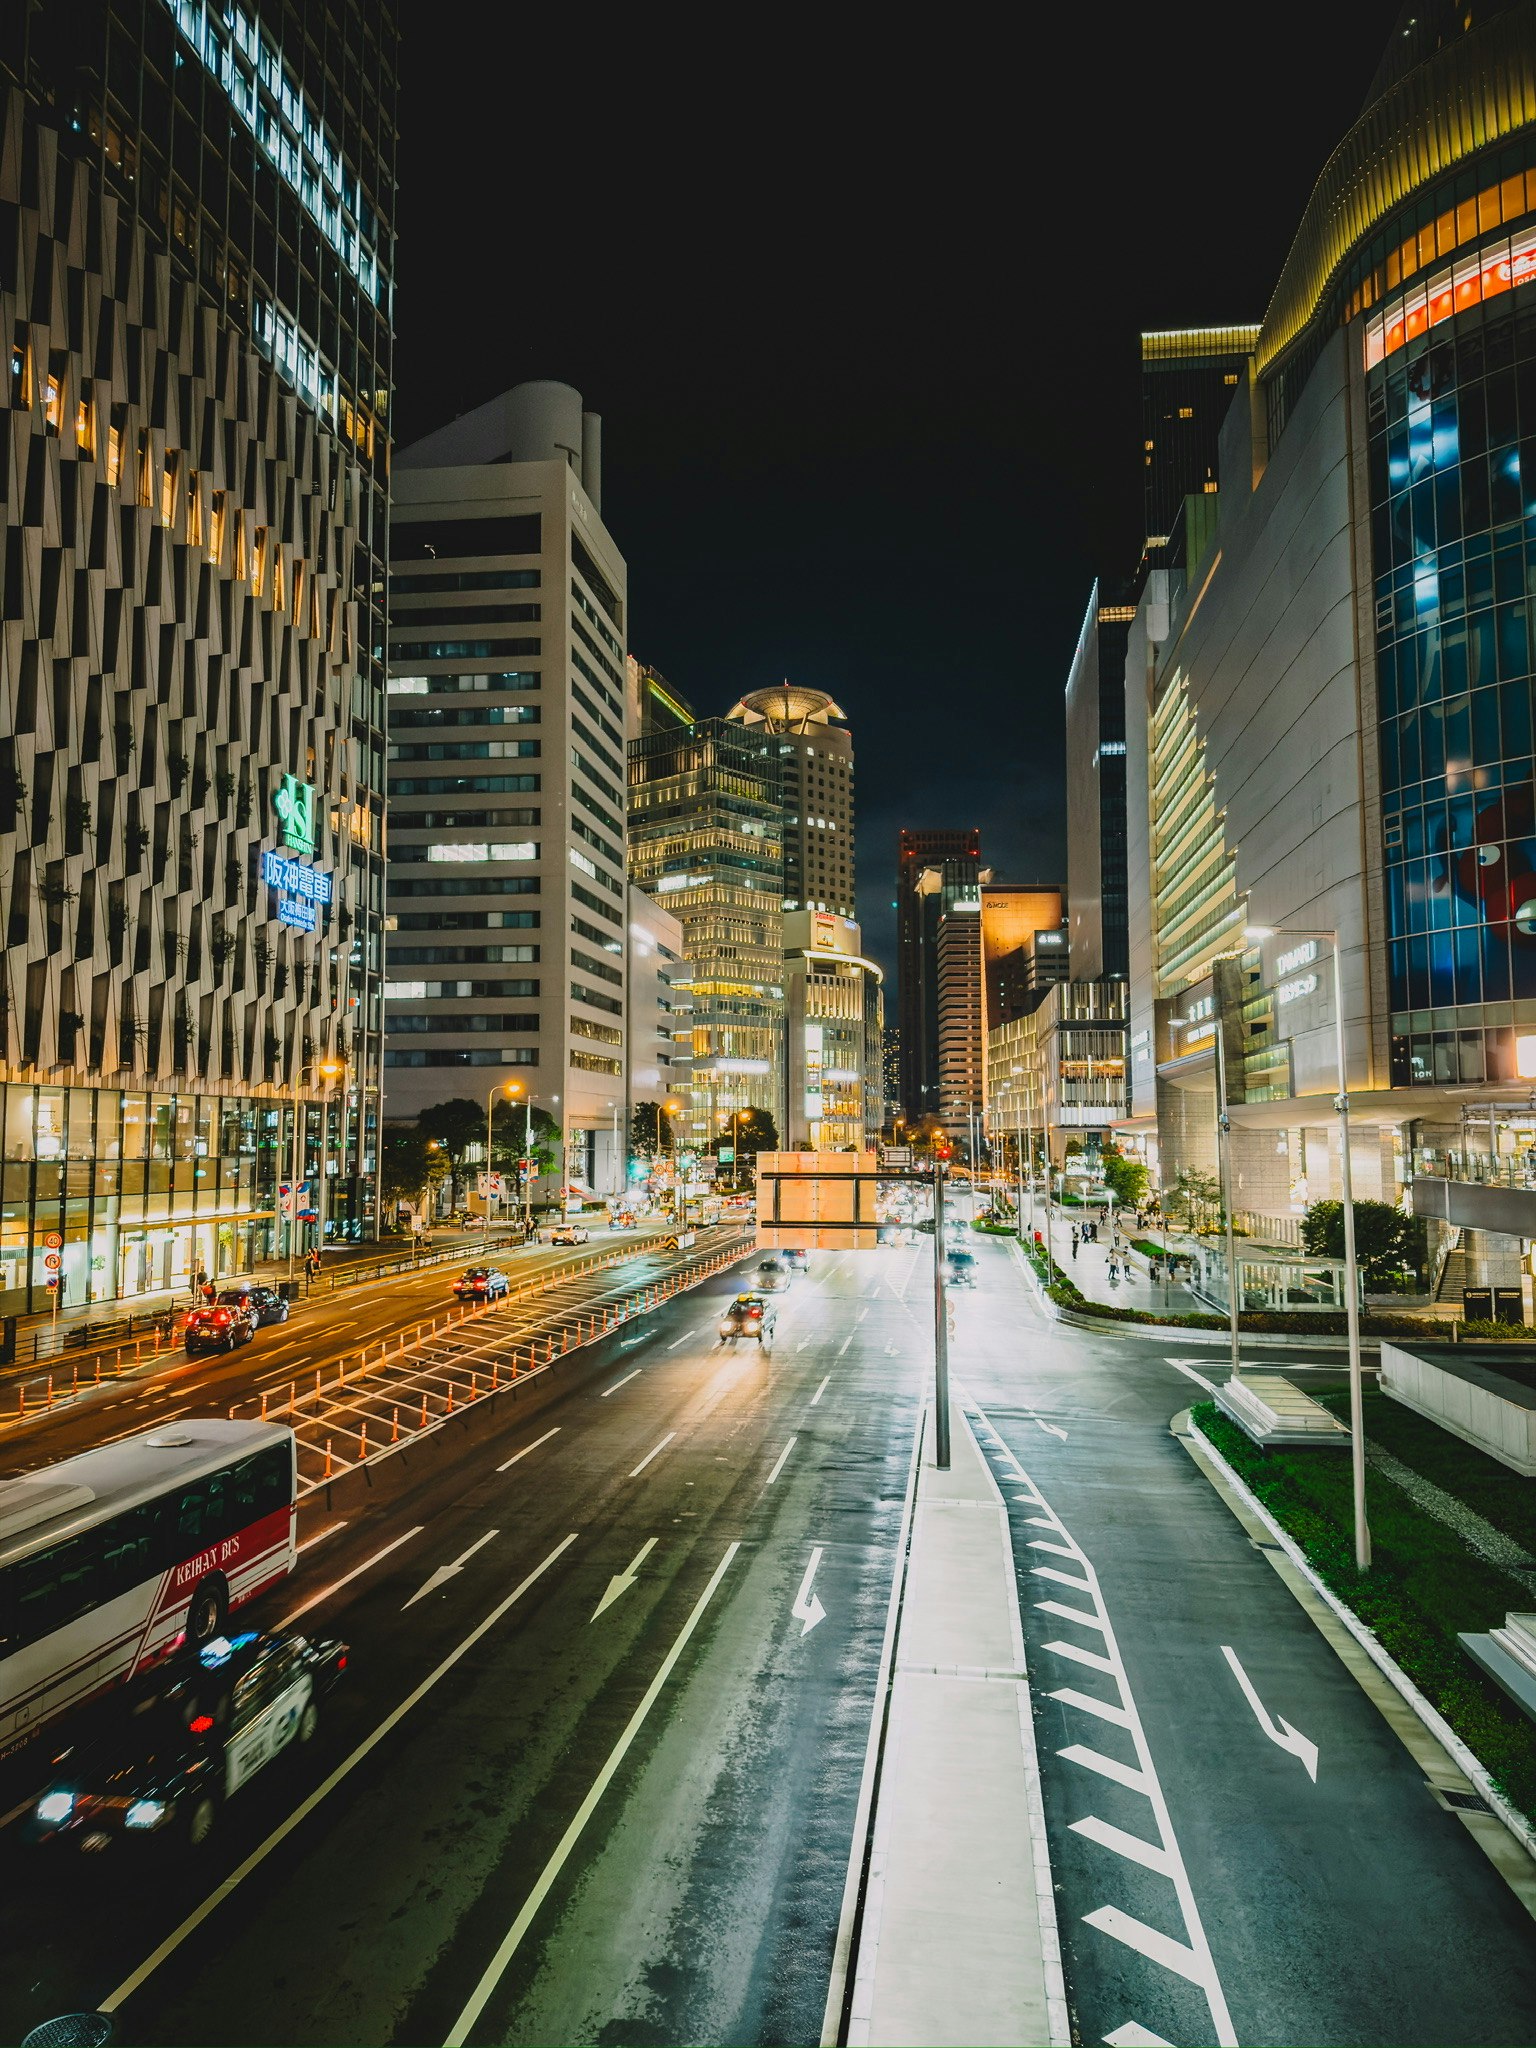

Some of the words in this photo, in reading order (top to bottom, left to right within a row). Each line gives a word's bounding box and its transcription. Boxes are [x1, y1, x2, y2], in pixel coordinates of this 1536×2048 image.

[266, 852, 329, 904] 阪神電車
[49, 1236, 59, 1245] 40
[176, 1547, 217, 1587] KEIHAN
[221, 1535, 240, 1562] BUS
